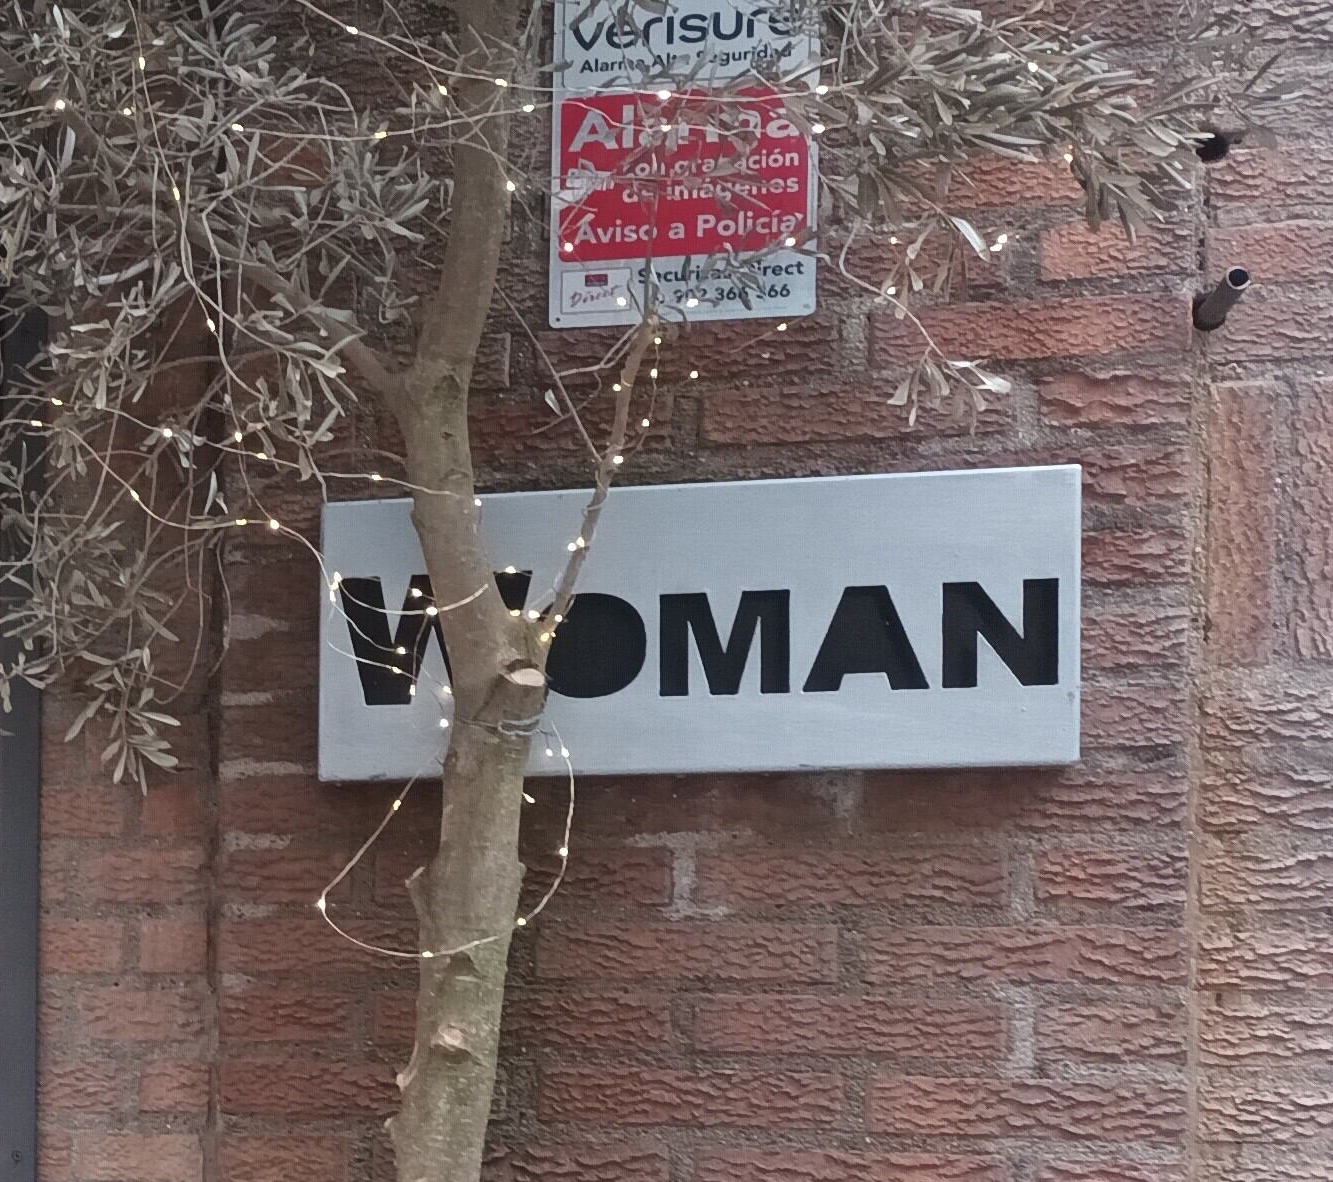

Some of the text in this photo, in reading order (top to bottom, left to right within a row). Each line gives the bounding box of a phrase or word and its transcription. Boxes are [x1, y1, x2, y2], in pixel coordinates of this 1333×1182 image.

[669, 222, 685, 240] a
[696, 210, 797, 240] Policía
[336, 568, 1059, 706] WOMAN
